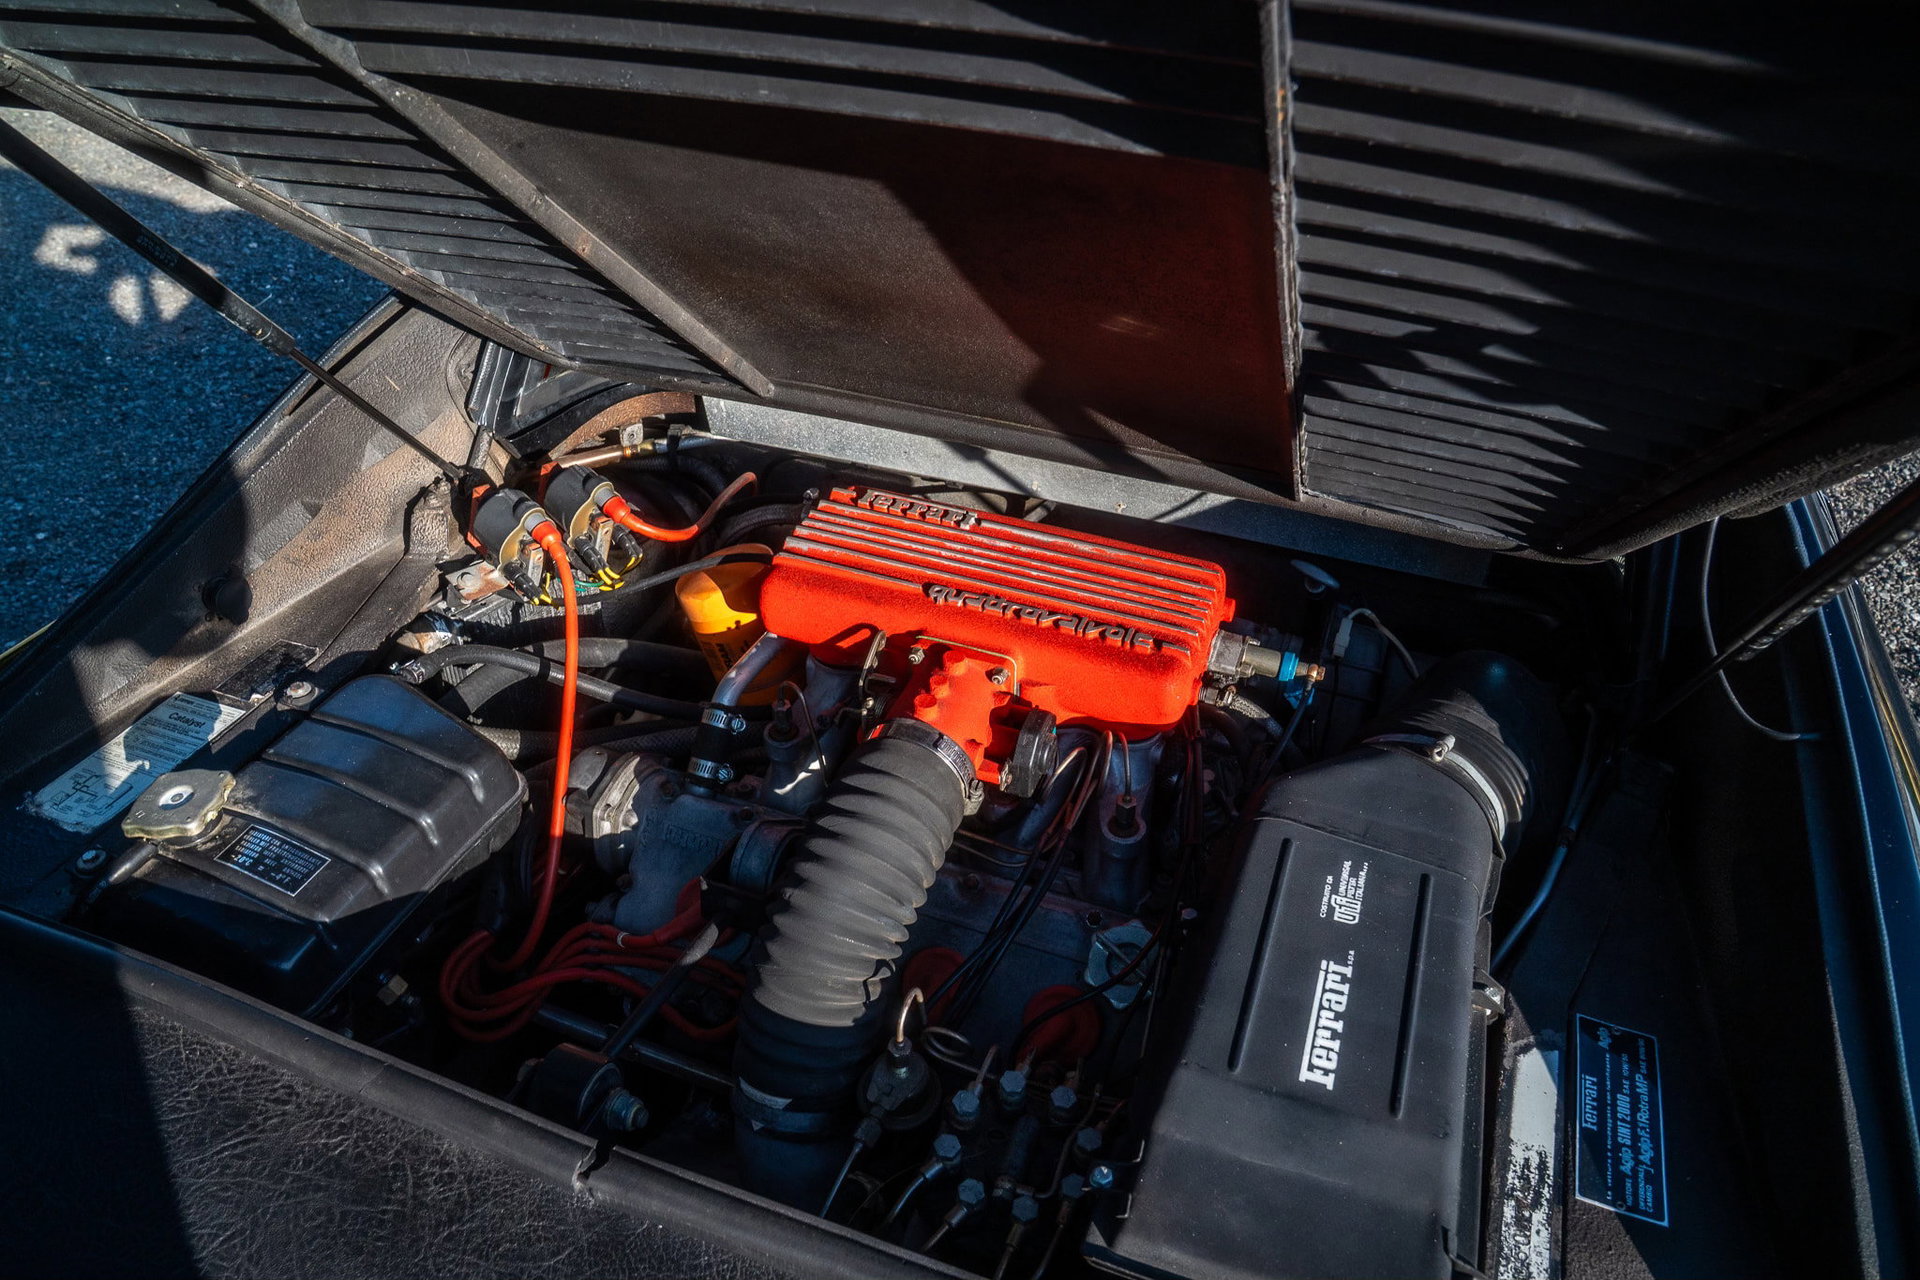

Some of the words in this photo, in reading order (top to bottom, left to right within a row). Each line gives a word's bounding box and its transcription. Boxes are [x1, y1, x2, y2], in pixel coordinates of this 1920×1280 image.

[169, 712, 206, 729] Catalyst
[1298, 959, 1353, 1090] Ferrari
[1596, 1026, 1612, 1050] Agip
[1622, 1079, 1630, 1094] SAE
[1581, 1073, 1598, 1131] Ferrari
[1616, 1094, 1631, 1120] 2000
[1617, 1121, 1632, 1146] SINT
[1619, 1147, 1635, 1175] Agip
[1637, 1136, 1654, 1165] Agip
[1624, 1178, 1633, 1206] MOTORE
[1645, 1184, 1654, 1213] CAMBIO
